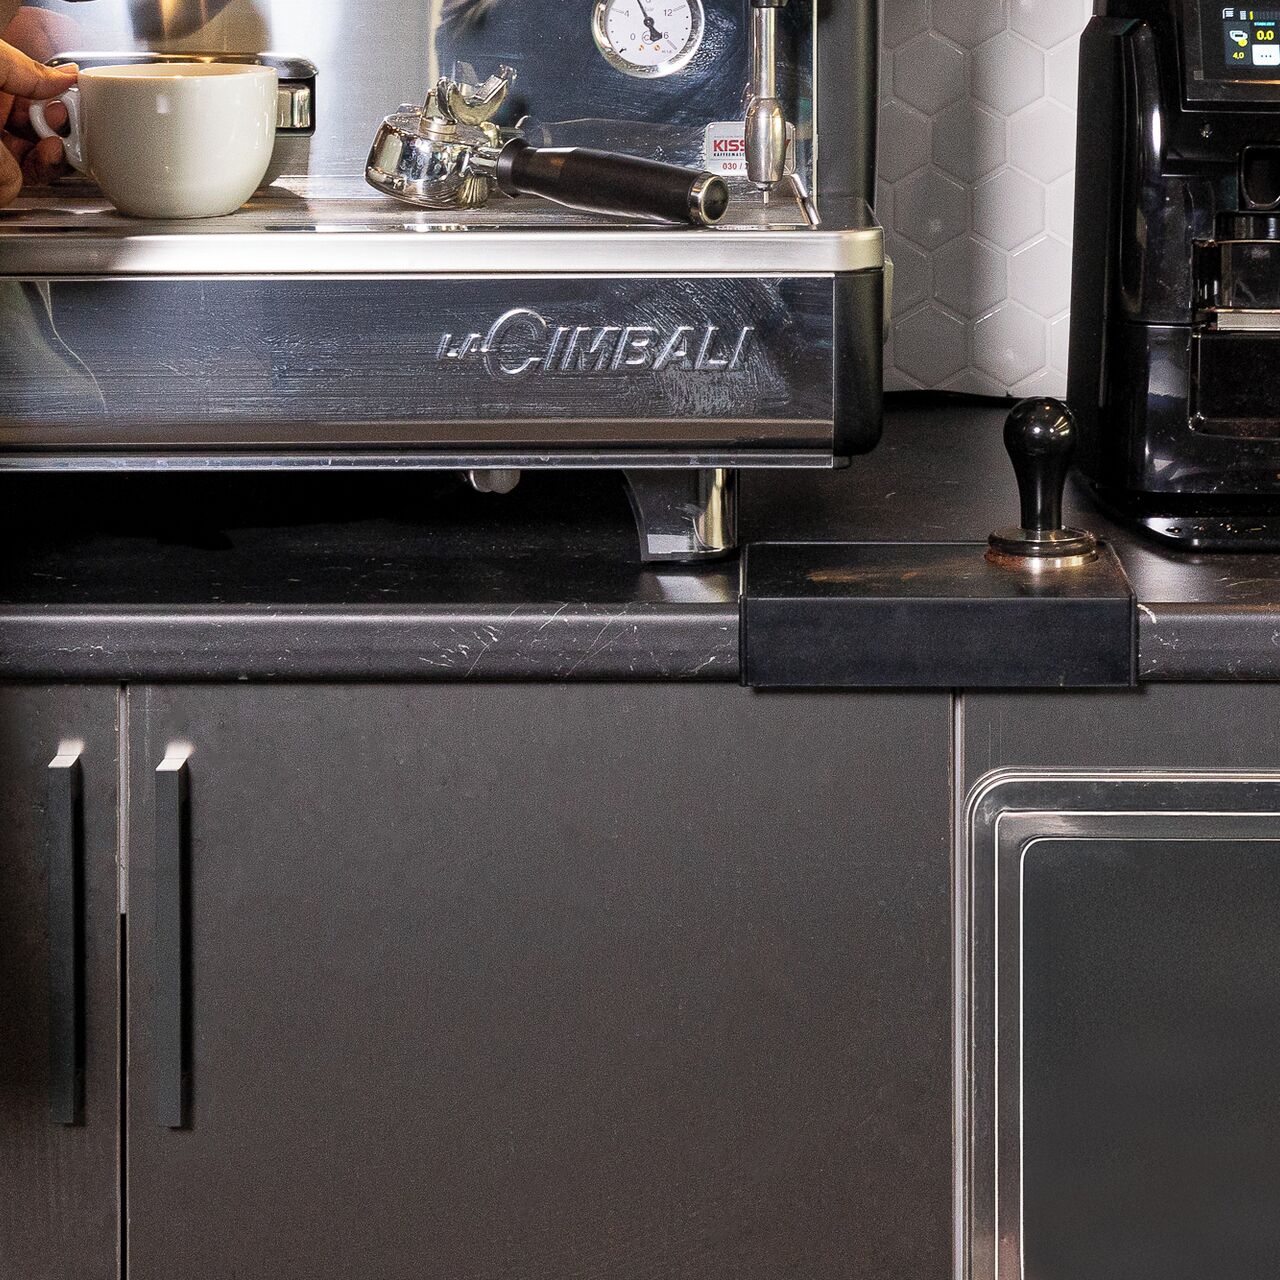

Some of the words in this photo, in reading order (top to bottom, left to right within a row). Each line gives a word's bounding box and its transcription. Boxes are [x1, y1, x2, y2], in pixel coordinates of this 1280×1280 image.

[664, 9, 673, 17] 12
[630, 33, 636, 41] 0
[1256, 29, 1274, 41] 0.0
[722, 162, 737, 170] 030
[482, 308, 755, 377] CIMBALI
